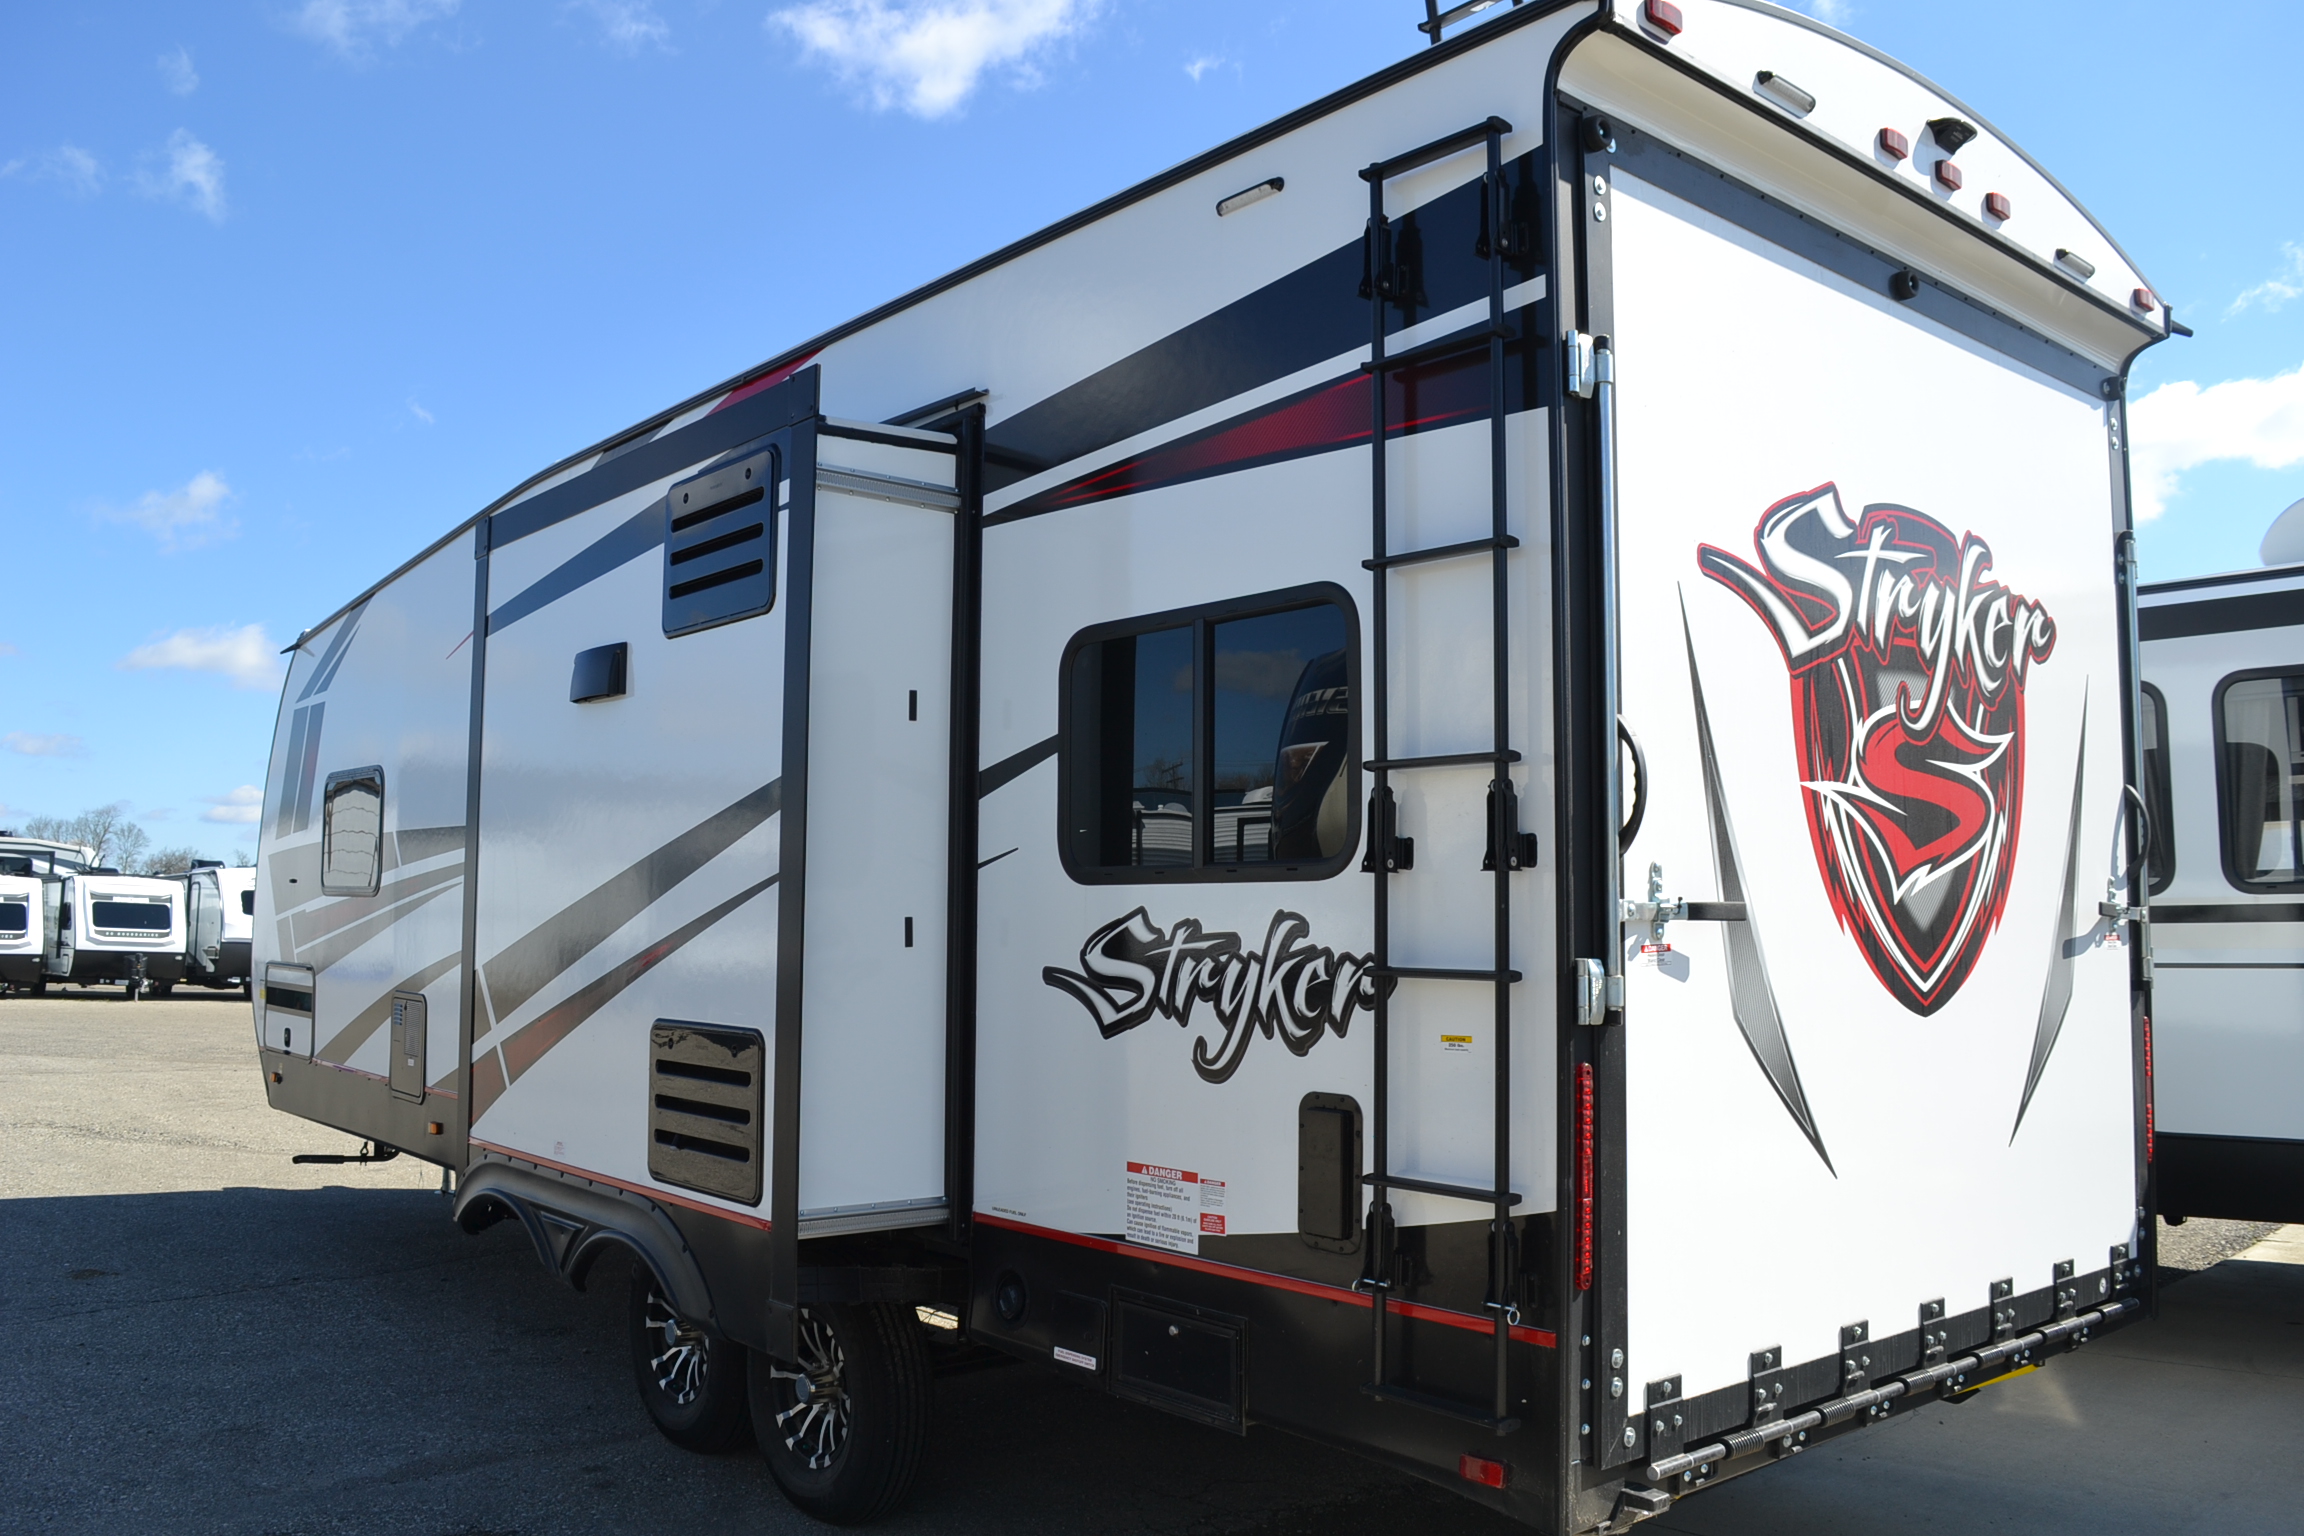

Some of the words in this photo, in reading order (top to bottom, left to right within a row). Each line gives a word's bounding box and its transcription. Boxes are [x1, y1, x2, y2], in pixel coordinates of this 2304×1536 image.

[1697, 481, 2057, 744] Stryker
[1042, 905, 1398, 1084] Stryker
[1149, 1166, 1182, 1180] DANGER
[1157, 1178, 1176, 1186] SMOKING
